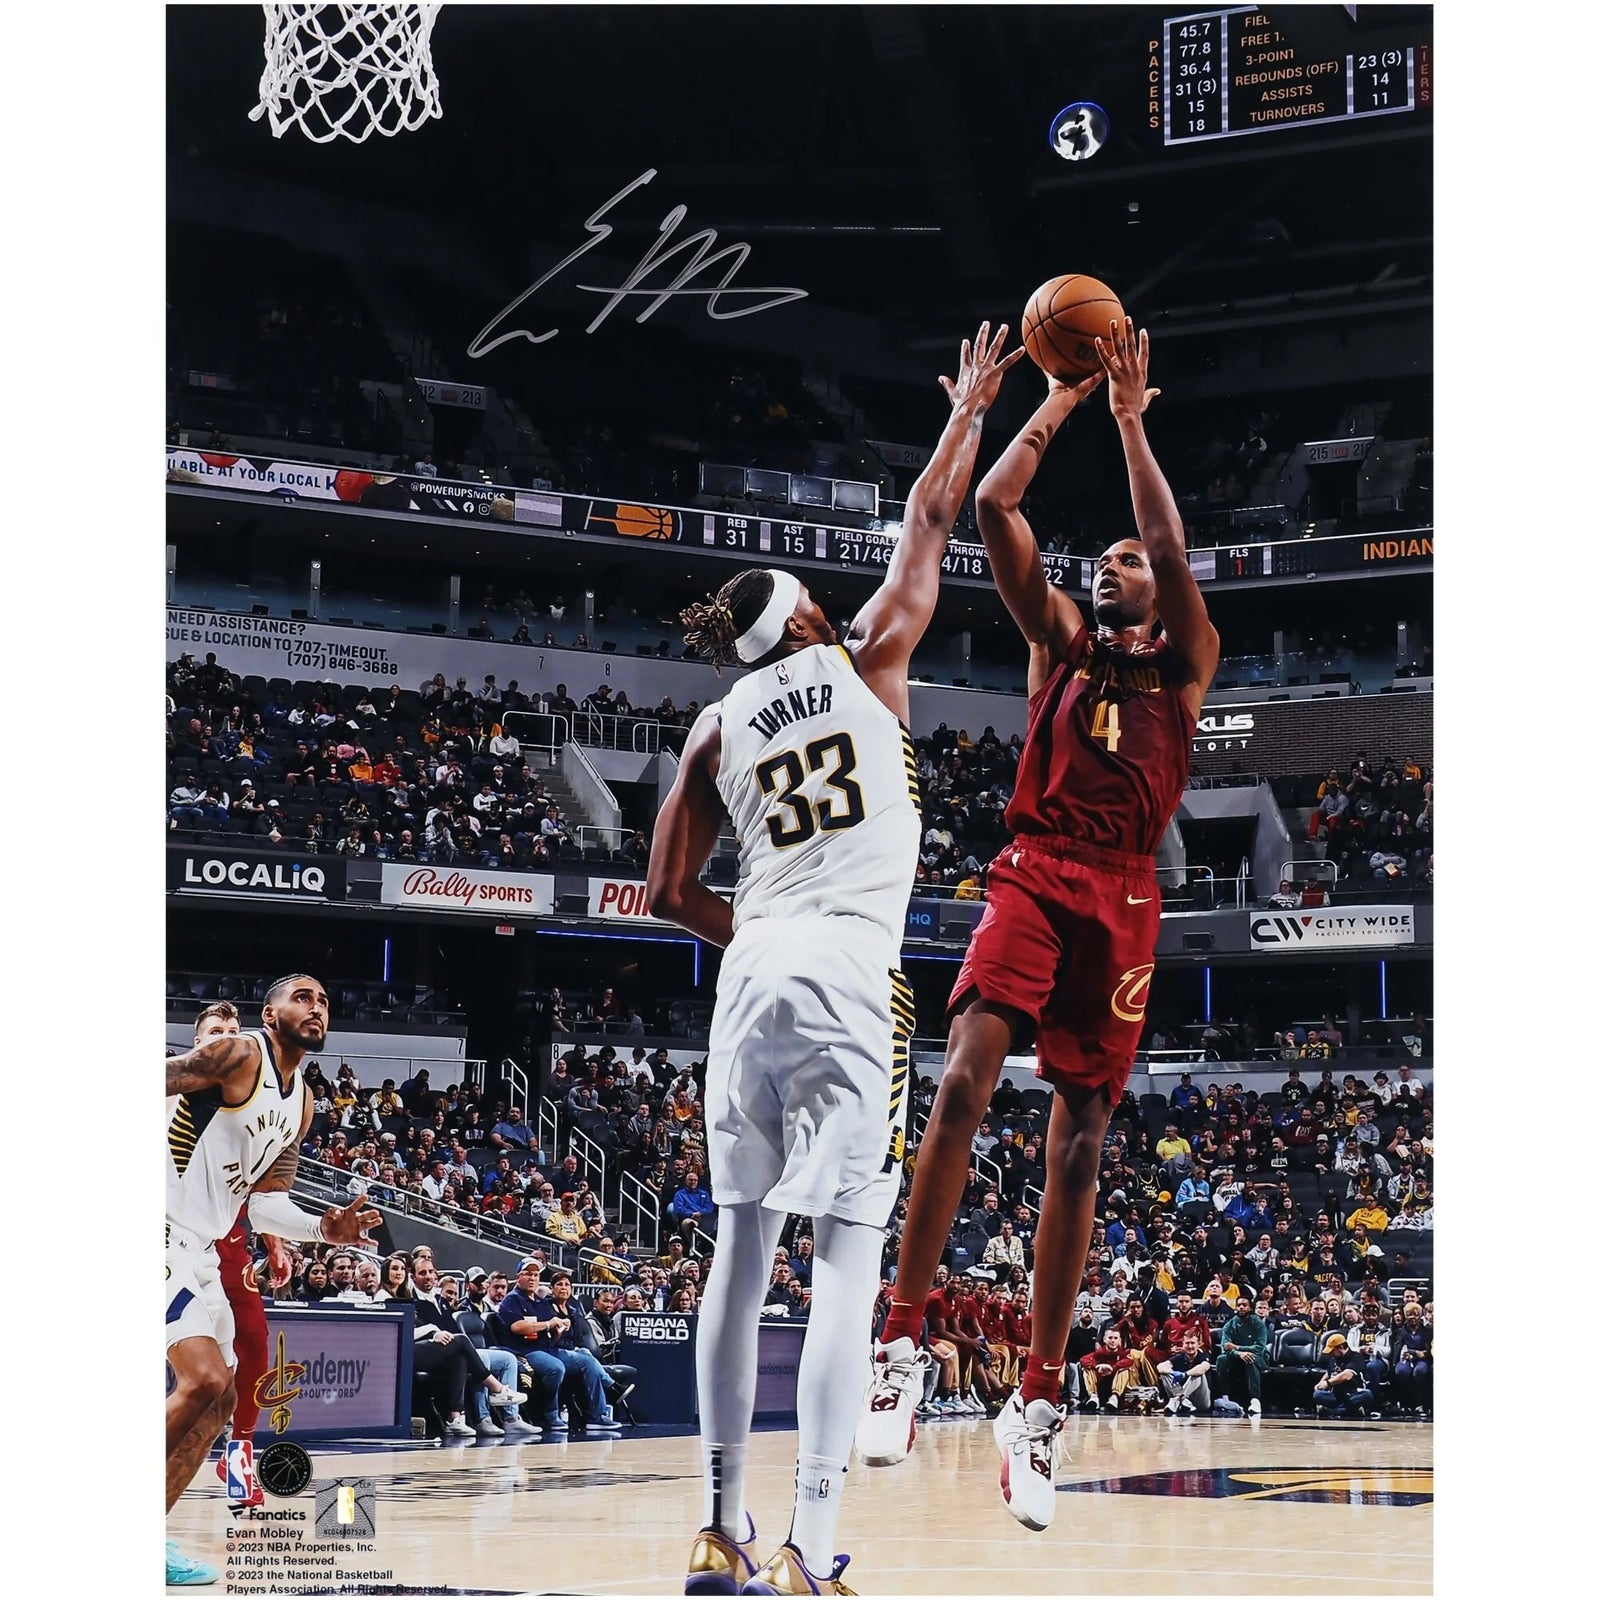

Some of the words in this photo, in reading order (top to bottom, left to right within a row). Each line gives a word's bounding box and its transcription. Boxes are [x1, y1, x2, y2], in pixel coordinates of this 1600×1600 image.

[1179, 22, 1210, 38] 45.7
[1241, 34, 1270, 47] FREE
[1179, 42, 1211, 58] 77.8
[1358, 55, 1377, 69] 23
[1381, 50, 1402, 68] (3)
[1180, 61, 1211, 76] 36.4
[1235, 67, 1302, 86] REBOUNDS
[1306, 61, 1339, 78] (OFF)
[1149, 41, 1159, 128] PACERS
[1175, 82, 1191, 96] 31
[1197, 78, 1217, 95] (3)
[1372, 72, 1390, 86] 14
[1261, 84, 1313, 102] ASSISTS
[1372, 92, 1388, 106] 11
[1188, 100, 1205, 113] 15
[1250, 102, 1325, 122] TURNOVERS
[1188, 119, 1205, 132] 18
[1309, 447, 1328, 459] 215
[218, 466, 234, 478] AT
[239, 467, 276, 483] YOUR
[279, 472, 321, 488] LOCAL
[727, 518, 748, 529] REB
[783, 525, 804, 535] AST
[725, 530, 748, 547] 31
[783, 536, 804, 553] 15
[835, 531, 863, 542] FIELD
[865, 535, 897, 546] GOALS
[840, 543, 892, 563] 21/46
[949, 545, 989, 558] THROWS
[1230, 548, 1248, 558] FLS
[1058, 558, 1070, 568] FG
[1235, 559, 1242, 575] 1
[168, 611, 206, 626] NEED
[208, 613, 306, 636] ASSISTANCE?
[191, 629, 202, 642] &
[205, 630, 272, 650] LOCATION
[274, 638, 291, 651] TO
[294, 640, 389, 661] 707-TIMEOUT.
[287, 652, 326, 670] (707)
[329, 655, 398, 675] 846-3688
[605, 663, 611, 676] 8
[748, 684, 833, 740] TURNER
[1091, 699, 1121, 752] 4
[755, 732, 865, 850] 33
[403, 869, 479, 906] Bally
[479, 884, 534, 904] SPORTS
[909, 913, 931, 925] HQ
[1315, 918, 1356, 929] CITY
[1364, 915, 1410, 926] WIDE
[458, 1039, 464, 1055] 7
[553, 1044, 560, 1059] 8
[625, 1317, 688, 1328] INDIANA
[639, 1328, 689, 1340] BOLD
